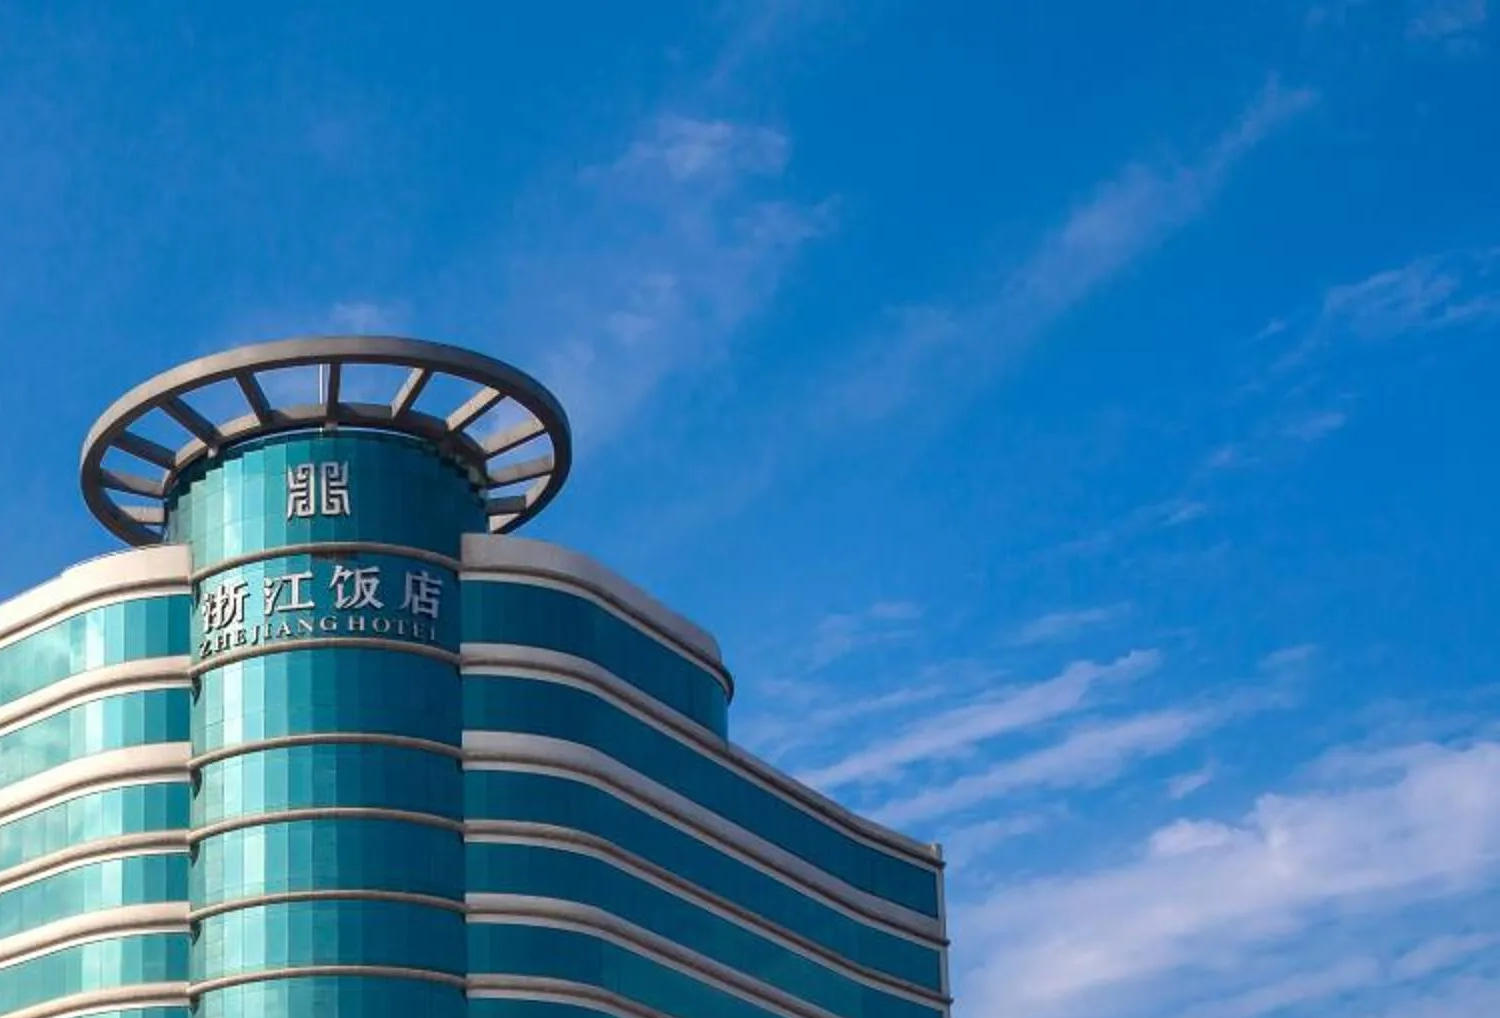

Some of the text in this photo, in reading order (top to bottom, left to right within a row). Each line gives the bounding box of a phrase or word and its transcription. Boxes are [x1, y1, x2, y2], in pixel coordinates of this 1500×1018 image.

[202, 565, 443, 634] 浙江饭店
[199, 615, 437, 659] ZHEJIANG HOTEL
